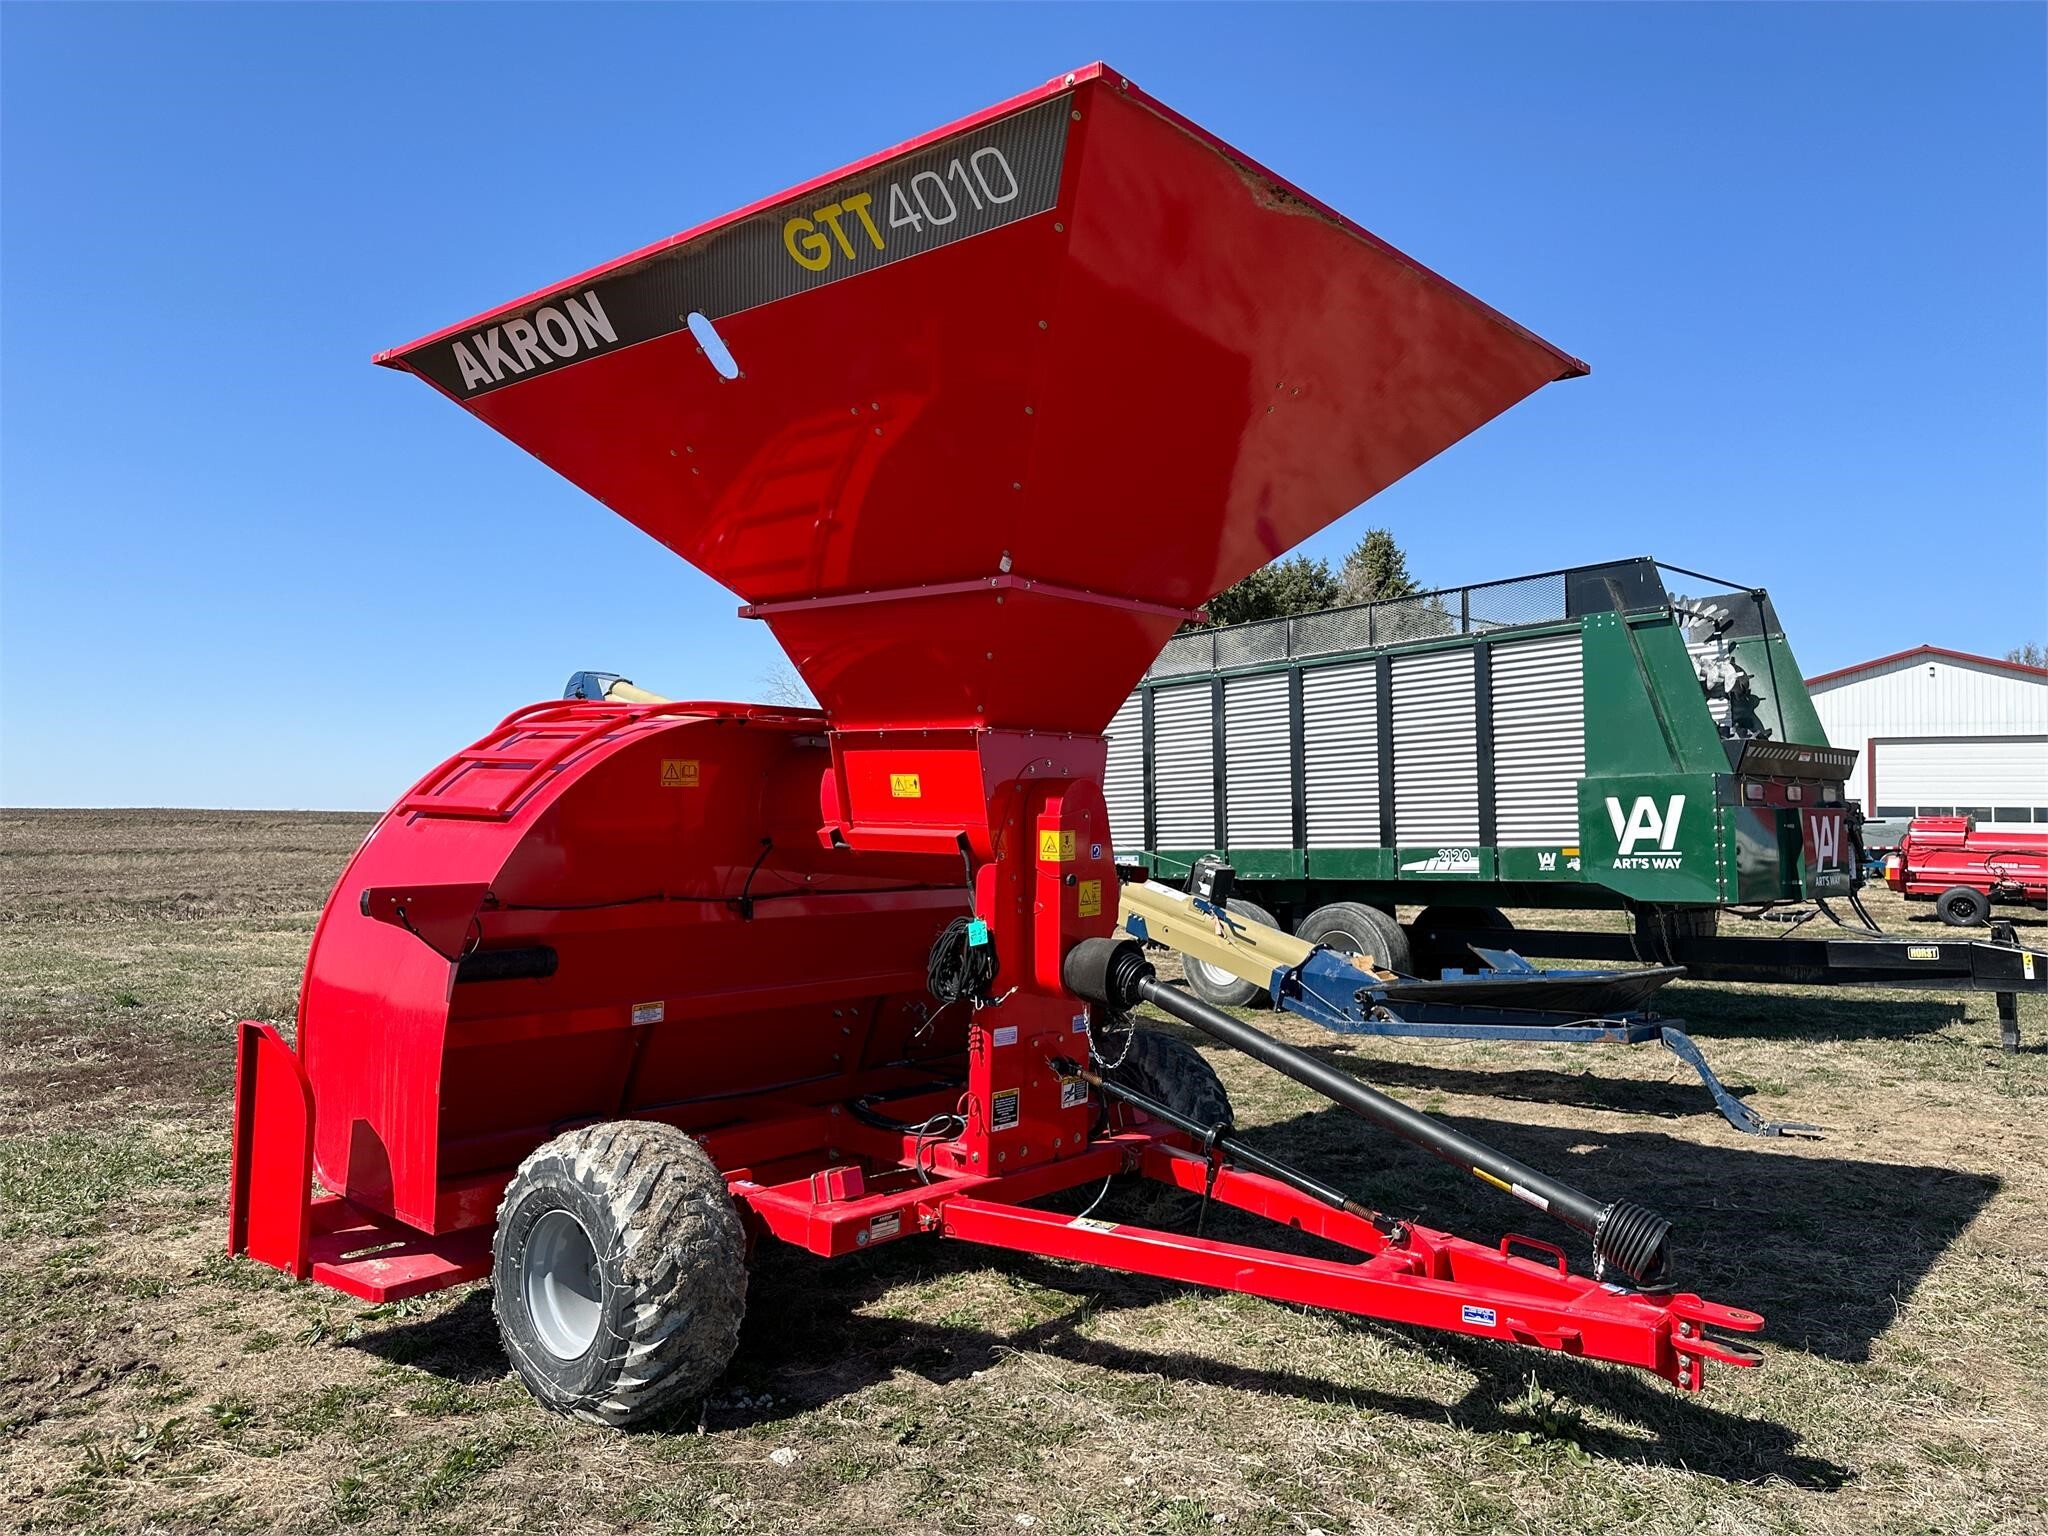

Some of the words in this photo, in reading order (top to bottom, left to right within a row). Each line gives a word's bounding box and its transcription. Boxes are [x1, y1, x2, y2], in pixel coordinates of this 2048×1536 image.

[451, 290, 618, 390] AKRON
[1438, 848, 1471, 863] 2120
[1612, 857, 1650, 869] ART'S
[1651, 857, 1682, 869] WAY
[1910, 947, 1937, 958] HORST
